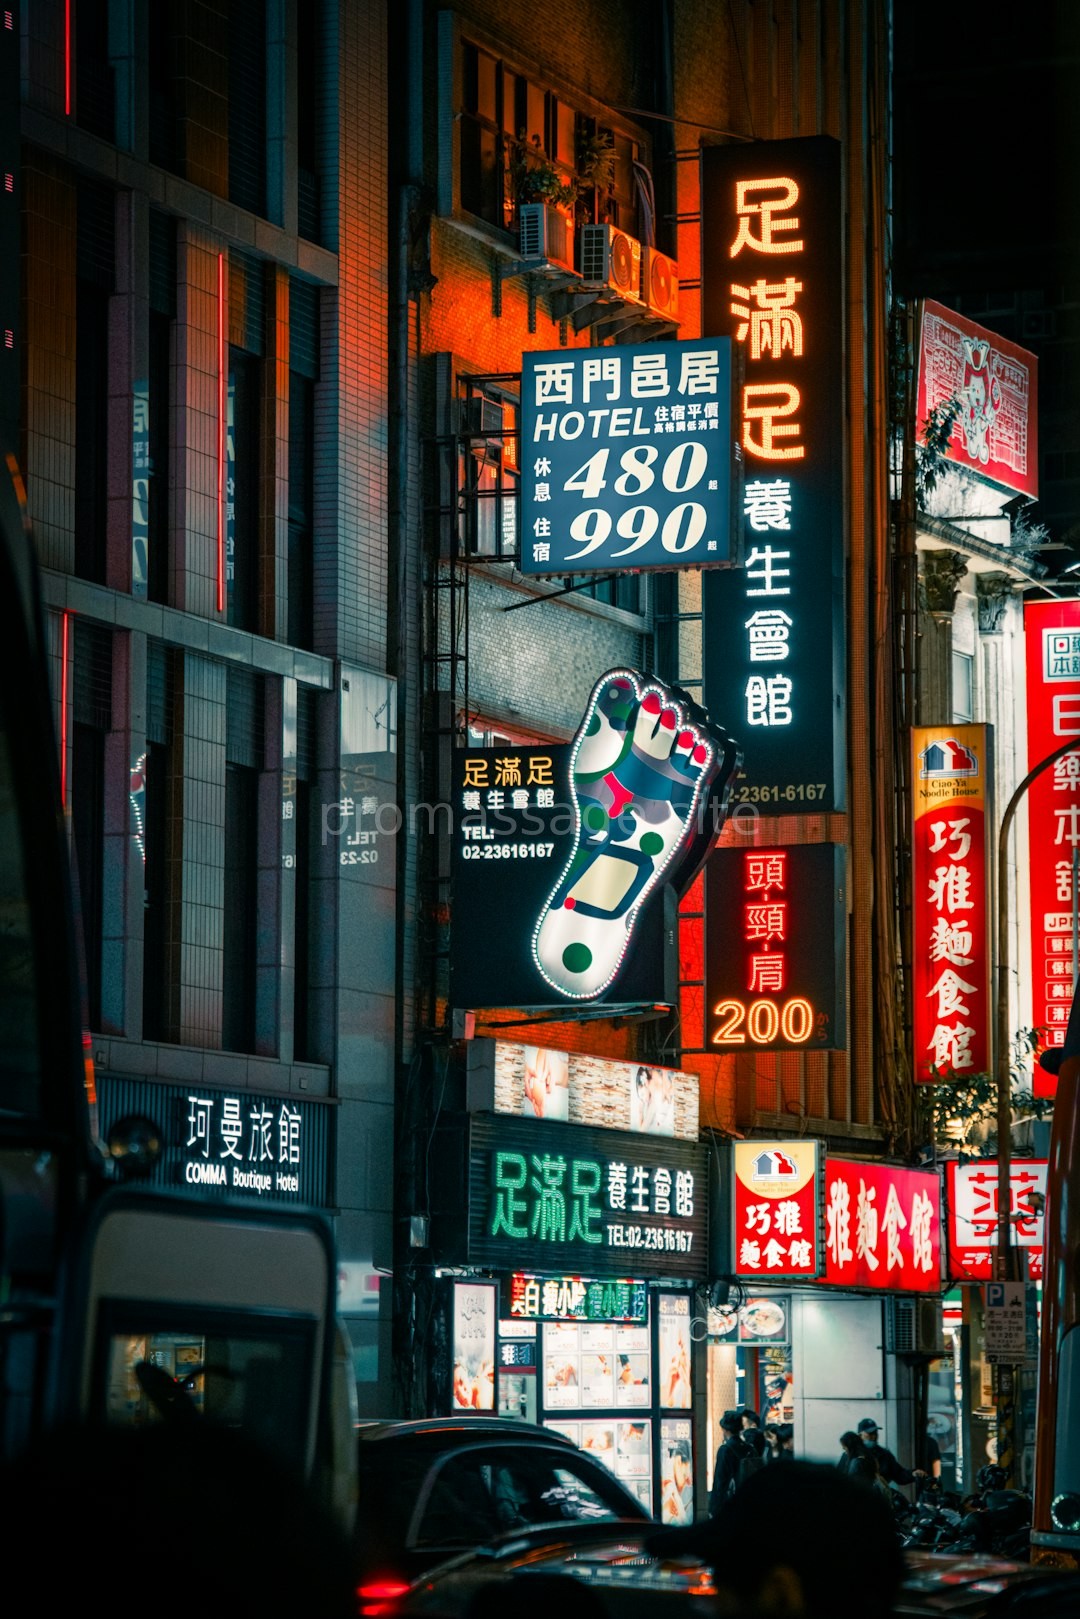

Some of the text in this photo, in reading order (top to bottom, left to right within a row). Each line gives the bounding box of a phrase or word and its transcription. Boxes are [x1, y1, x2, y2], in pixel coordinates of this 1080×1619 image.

[730, 176, 804, 460] 足滿足
[533, 350, 720, 406] 西門邑居
[533, 407, 651, 442] HOTEL
[654, 402, 719, 422] 住宿平價
[654, 419, 719, 433] 高格調低消費
[533, 457, 551, 502] 休息
[563, 441, 709, 499] 480
[708, 480, 718, 490] 起
[533, 517, 551, 562] 住宿
[563, 502, 718, 561] 990 起
[744, 479, 793, 726] 養生會館
[463, 756, 554, 788] 足滿足
[931, 779, 967, 788] Ciao-Ya
[463, 788, 554, 810] 養生會館
[919, 788, 979, 798] Noodle House
[462, 826, 495, 841] TEL:
[462, 843, 555, 860] 02-23616167
[926, 818, 978, 1069] 巧雅麵食館
[712, 998, 814, 1043] 200
[187, 1096, 302, 1165] 珂曼旅館
[186, 1162, 299, 1194] COMMA Boutique Hotel
[608, 1161, 694, 1217] 養生會館
[492, 1152, 602, 1244] 足滿足
[745, 1200, 803, 1237] 巧雅
[607, 1225, 694, 1252] TEL:02-23616167
[739, 1238, 812, 1269] 麵食館
[989, 1286, 1002, 1305] P
